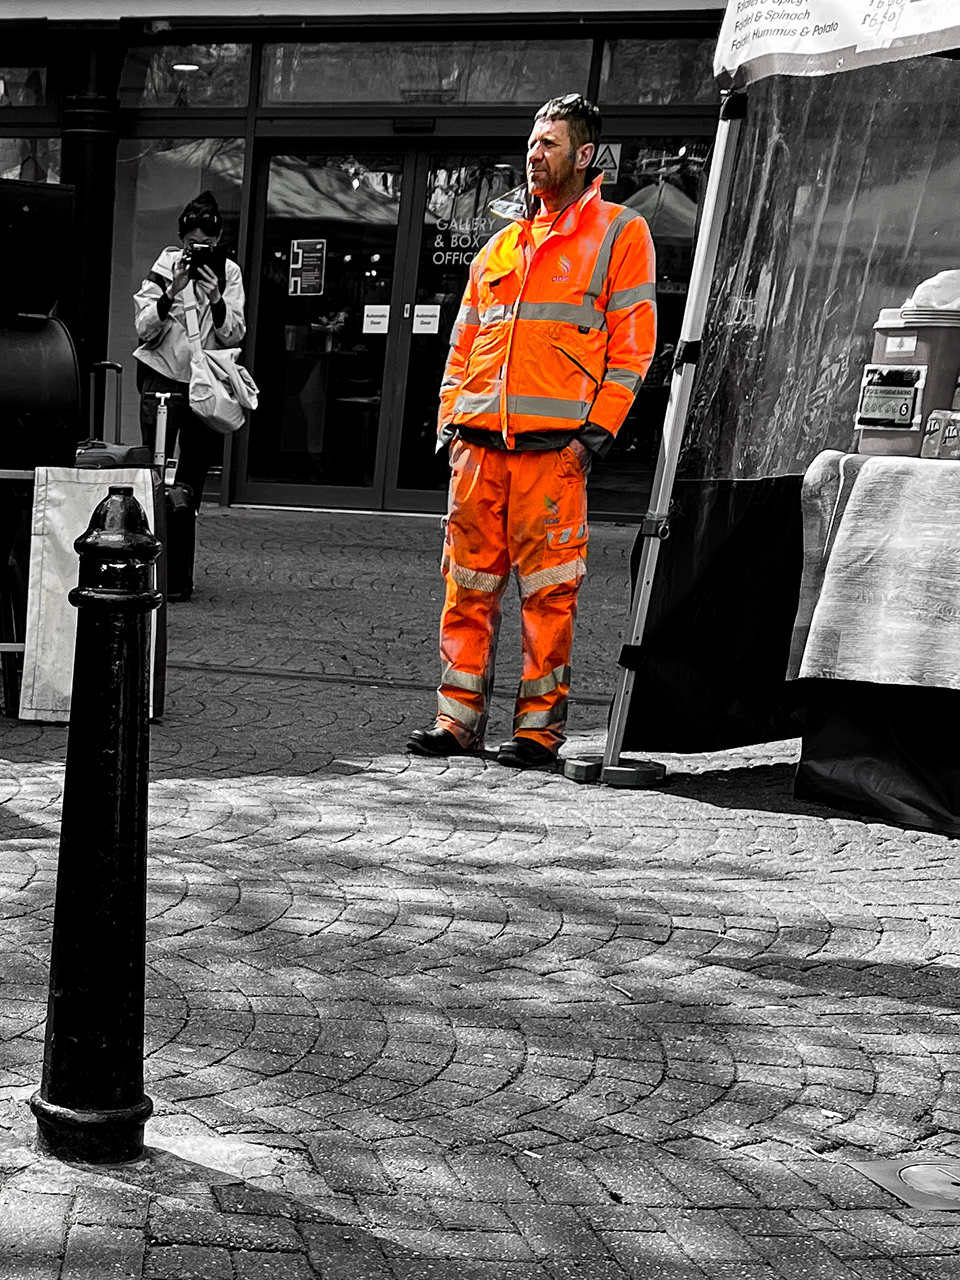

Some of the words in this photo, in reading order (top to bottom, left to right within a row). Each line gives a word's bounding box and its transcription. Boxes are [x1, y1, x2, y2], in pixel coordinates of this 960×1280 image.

[765, 9, 810, 22] Spinach
[752, 28, 797, 40] Hummus
[799, 26, 810, 37] &
[812, 21, 838, 36] Potato
[436, 217, 495, 231] GALLERY
[434, 234, 445, 248] &
[451, 234, 480, 248] BOX
[433, 252, 477, 265] OFFIC
